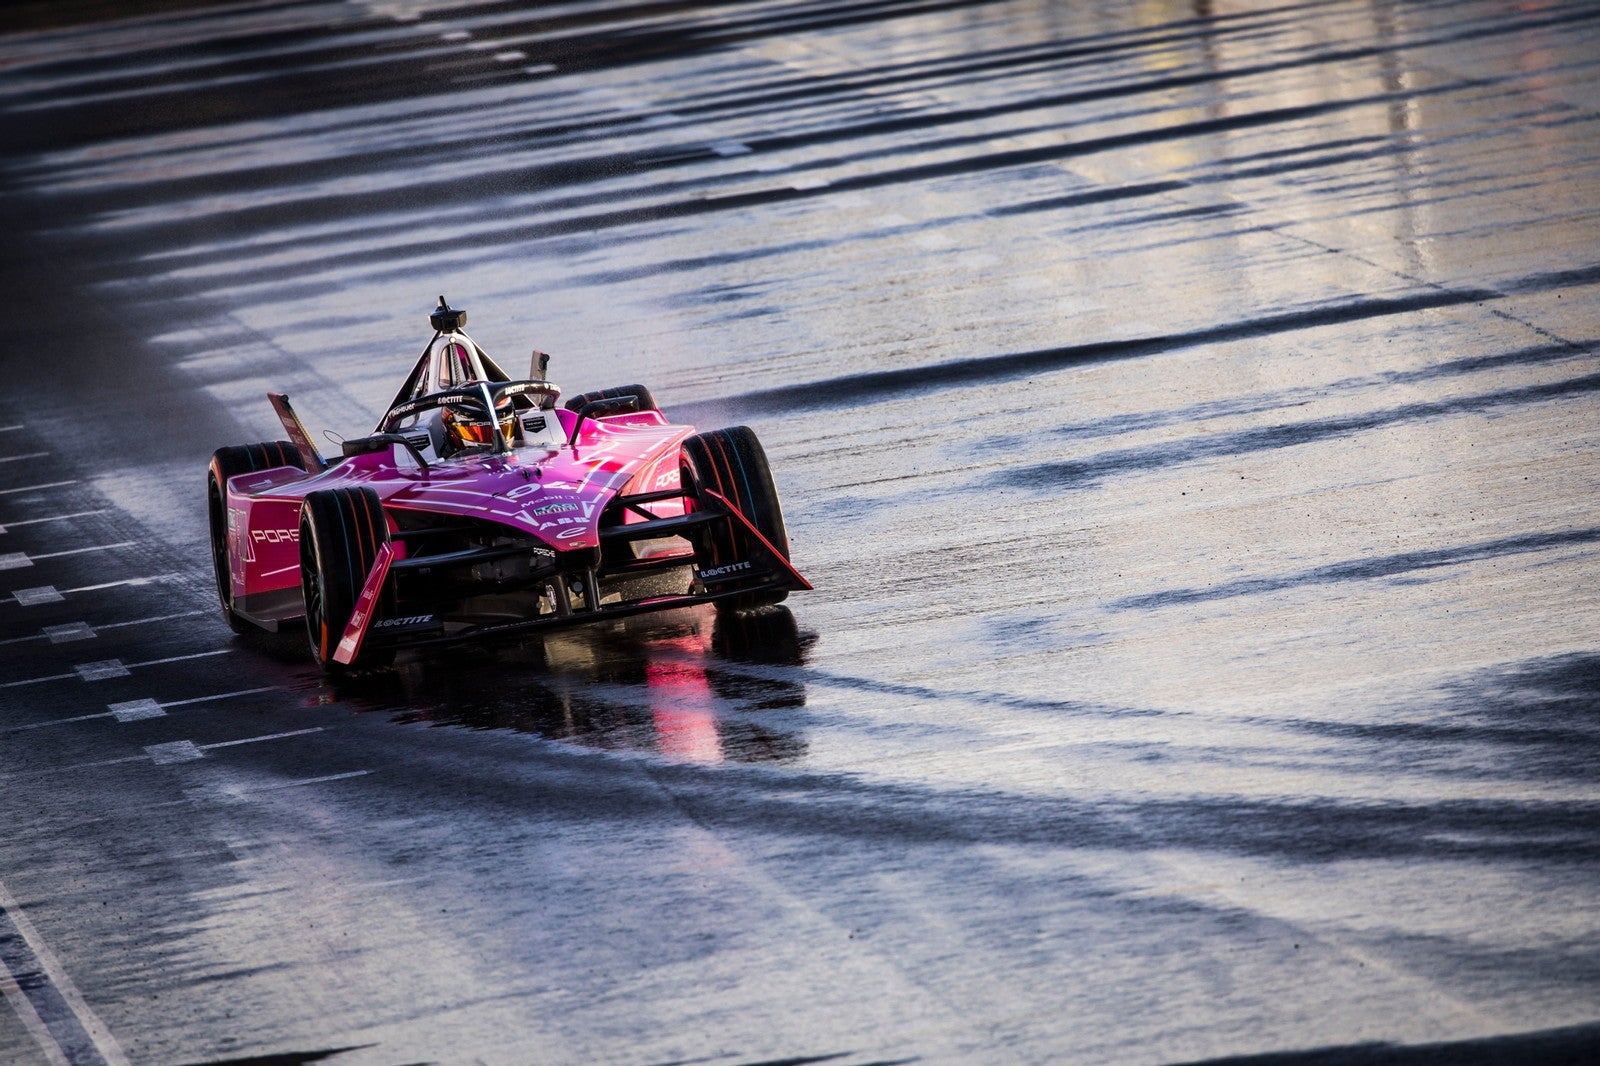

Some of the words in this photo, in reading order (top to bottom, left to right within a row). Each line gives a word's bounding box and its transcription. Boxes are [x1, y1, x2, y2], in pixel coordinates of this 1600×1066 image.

[437, 395, 464, 405] LOCTITE
[533, 547, 556, 558] PORSCHE
[700, 560, 751, 578] LOCTITE
[374, 614, 433, 628] LOCTITE
